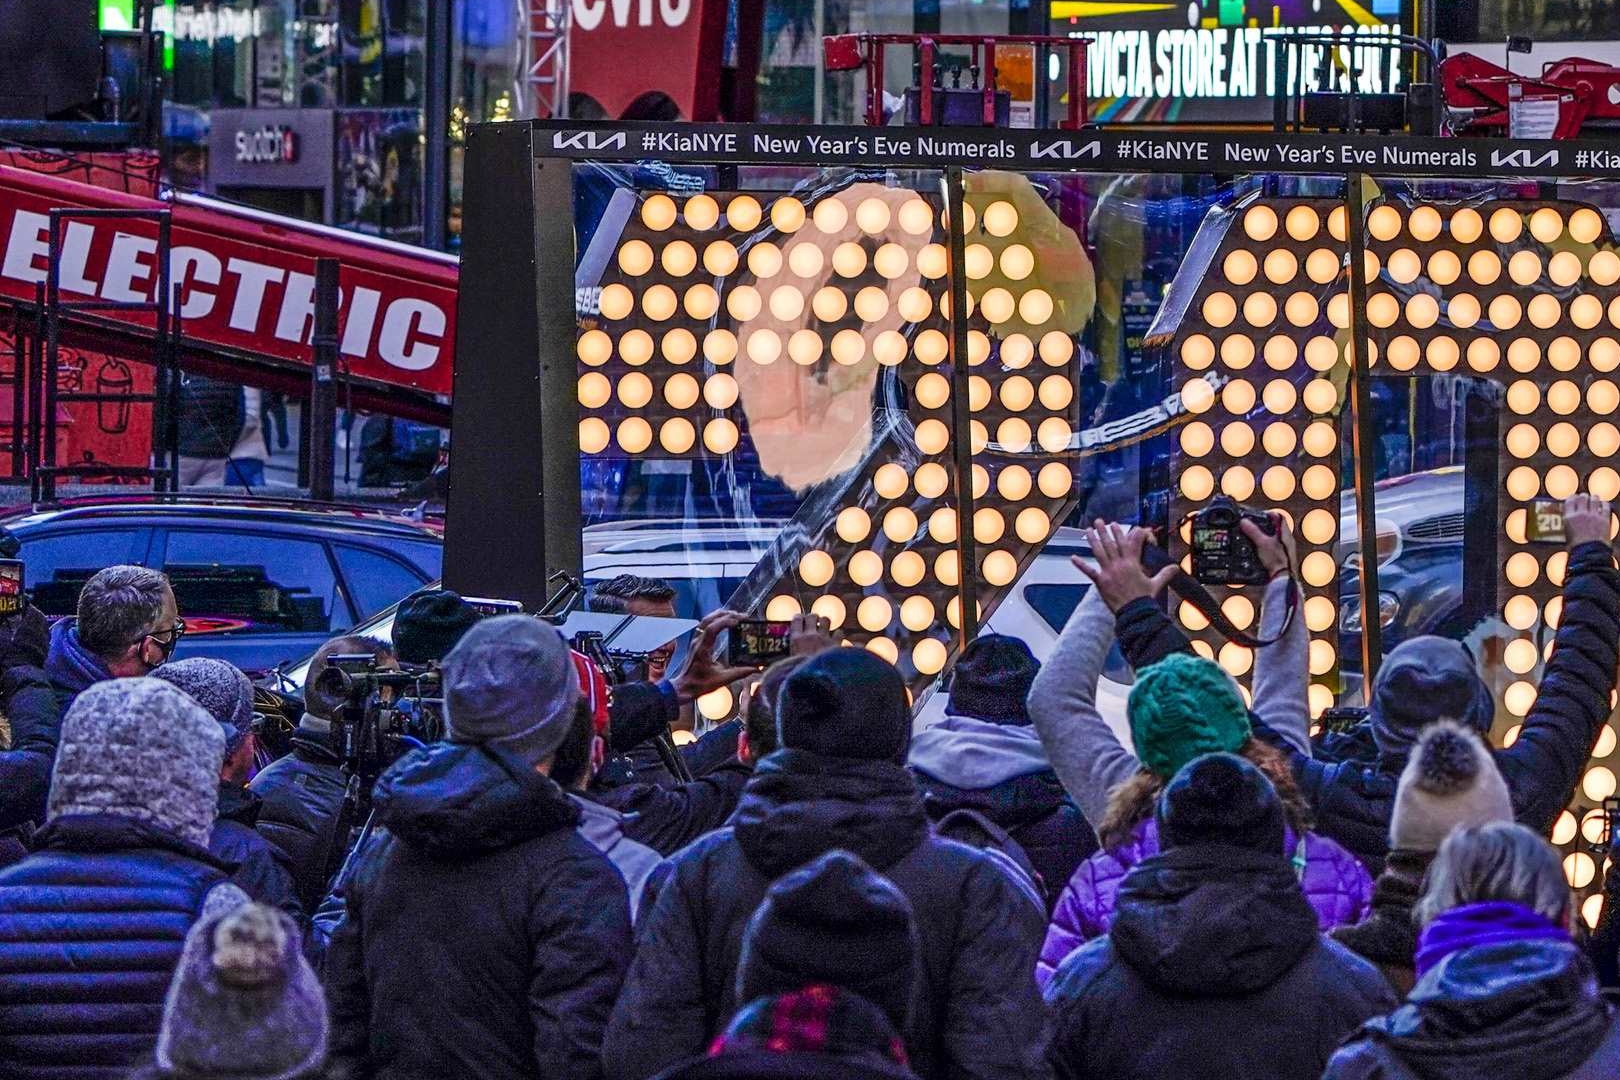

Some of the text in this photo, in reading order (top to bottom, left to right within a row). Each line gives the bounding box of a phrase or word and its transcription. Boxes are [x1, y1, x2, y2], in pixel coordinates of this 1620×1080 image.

[1069, 30, 1154, 98] VICTA
[1155, 29, 1228, 98] STORE
[1229, 28, 1261, 97] AT
[641, 133, 737, 152] #KiaNYE
[753, 134, 800, 153] New
[806, 135, 868, 154] Year's
[875, 137, 911, 155] Eve
[918, 138, 1016, 158] Numerals
[1118, 141, 1209, 160] #KiaNYE
[1225, 143, 1270, 161] New
[1276, 145, 1335, 163] Year's
[1342, 146, 1377, 164] Eve
[1383, 147, 1477, 166] Numerals
[1, 209, 447, 371] ELECTRIC
